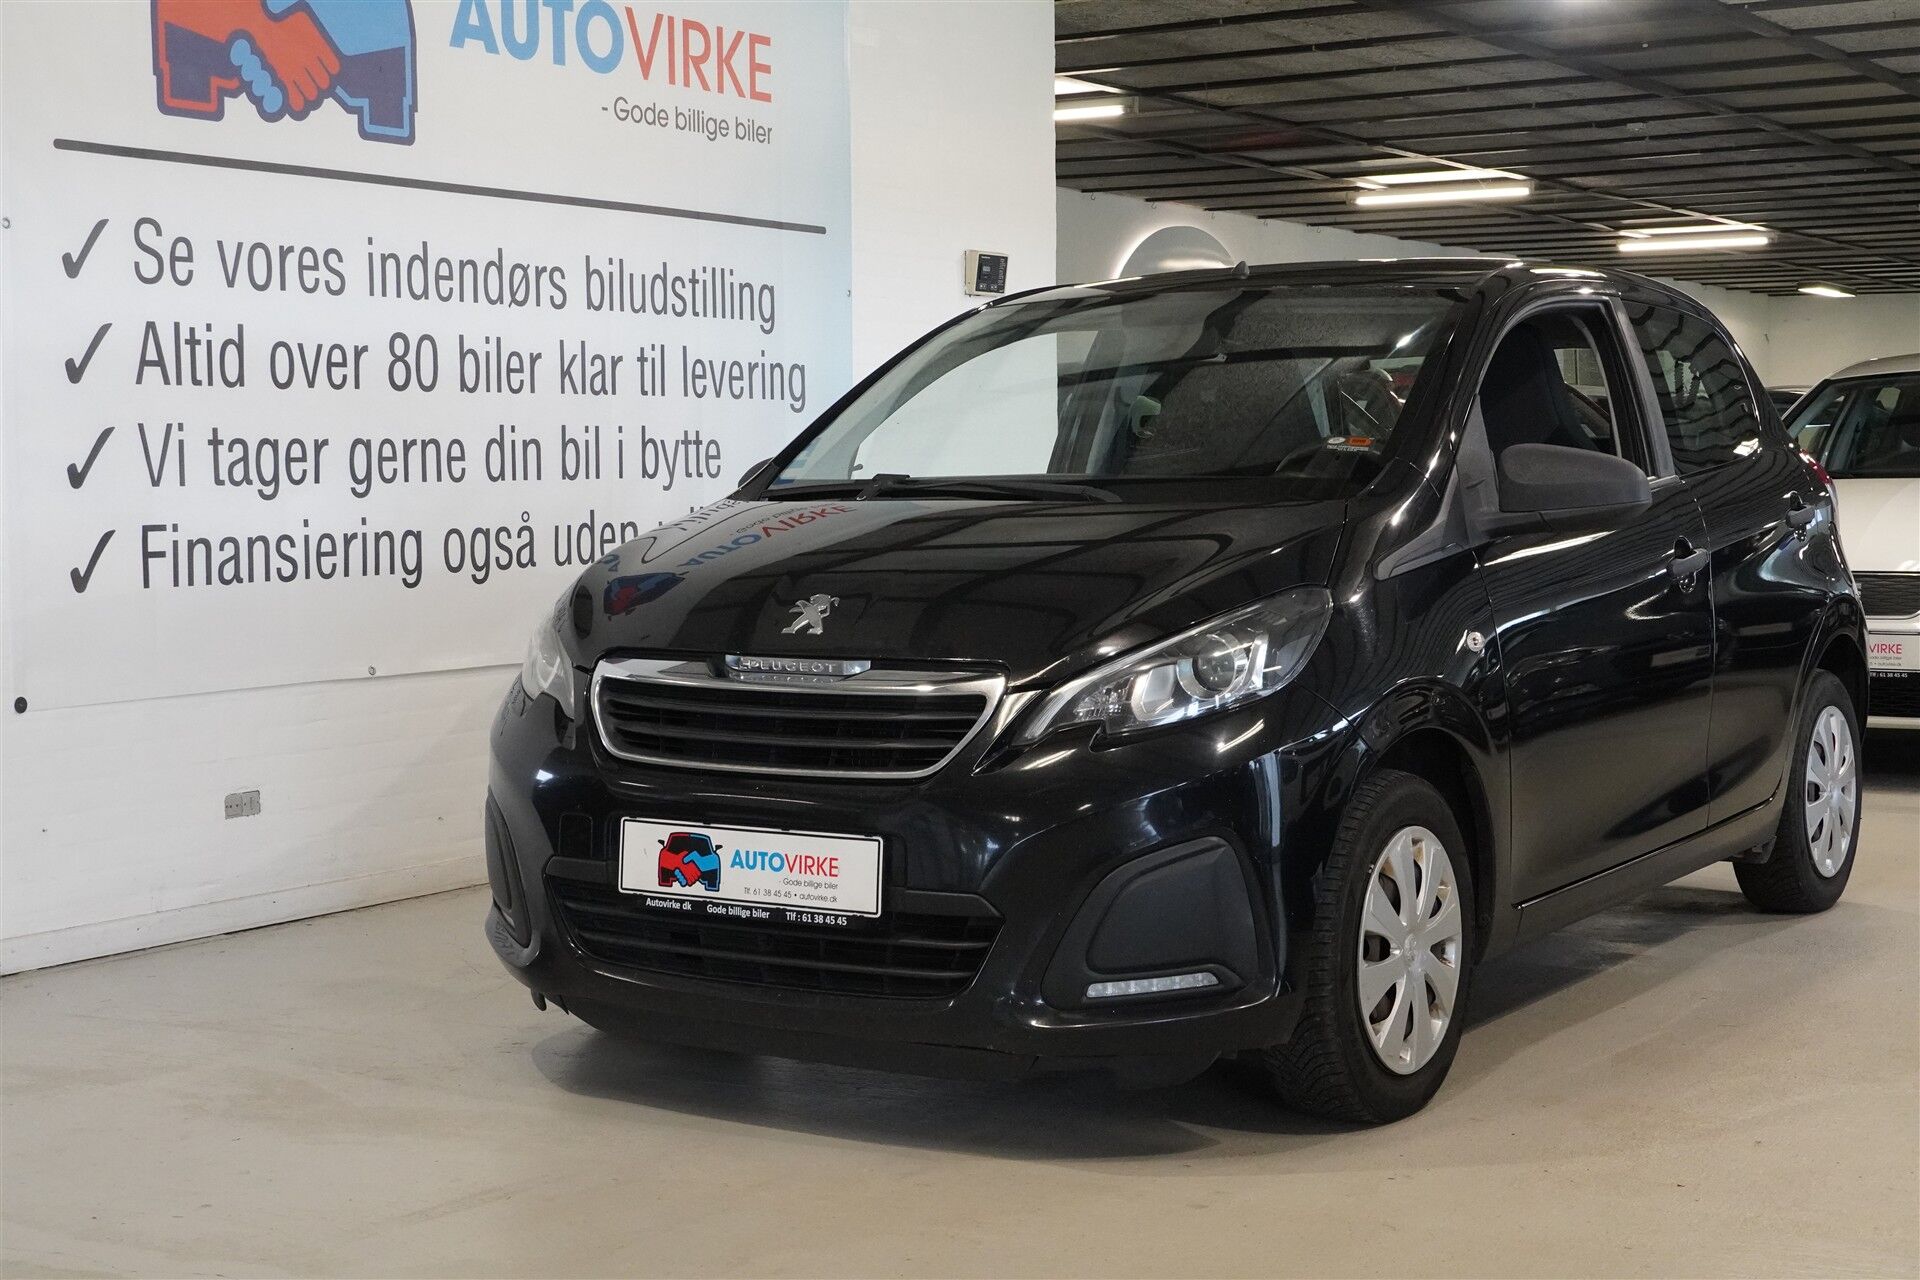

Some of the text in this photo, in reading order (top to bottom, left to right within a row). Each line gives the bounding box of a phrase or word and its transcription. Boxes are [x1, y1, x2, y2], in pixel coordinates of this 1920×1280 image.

[449, 0, 772, 103] AUTOVIRKE
[613, 96, 669, 128] Gode
[675, 106, 730, 142] billige
[736, 116, 773, 145] biler
[134, 217, 776, 335] Se vores indendørs biludstilling
[135, 320, 806, 414] Altid over 80 biler klar til levering
[137, 422, 722, 501] Vi tager gerne din bil i bytte
[141, 516, 423, 590] Finansiering
[443, 510, 537, 586] også
[554, 509, 639, 567] uden
[730, 849, 839, 877] AUTOVIRKE
[753, 888, 761, 896] 61
[763, 888, 772, 897] 38
[773, 889, 782, 898] 45
[783, 890, 792, 899] 45
[782, 878, 802, 887] Gode
[803, 880, 823, 890] billige
[824, 882, 839, 890] biler
[645, 897, 682, 910] Autovirke
[682, 901, 692, 911] dk
[706, 904, 727, 915] Gode
[728, 905, 750, 918] billige
[752, 908, 771, 919] biler
[802, 913, 812, 923] 61
[813, 914, 824, 924] 38
[825, 915, 836, 925] 45
[836, 916, 847, 926] 45
